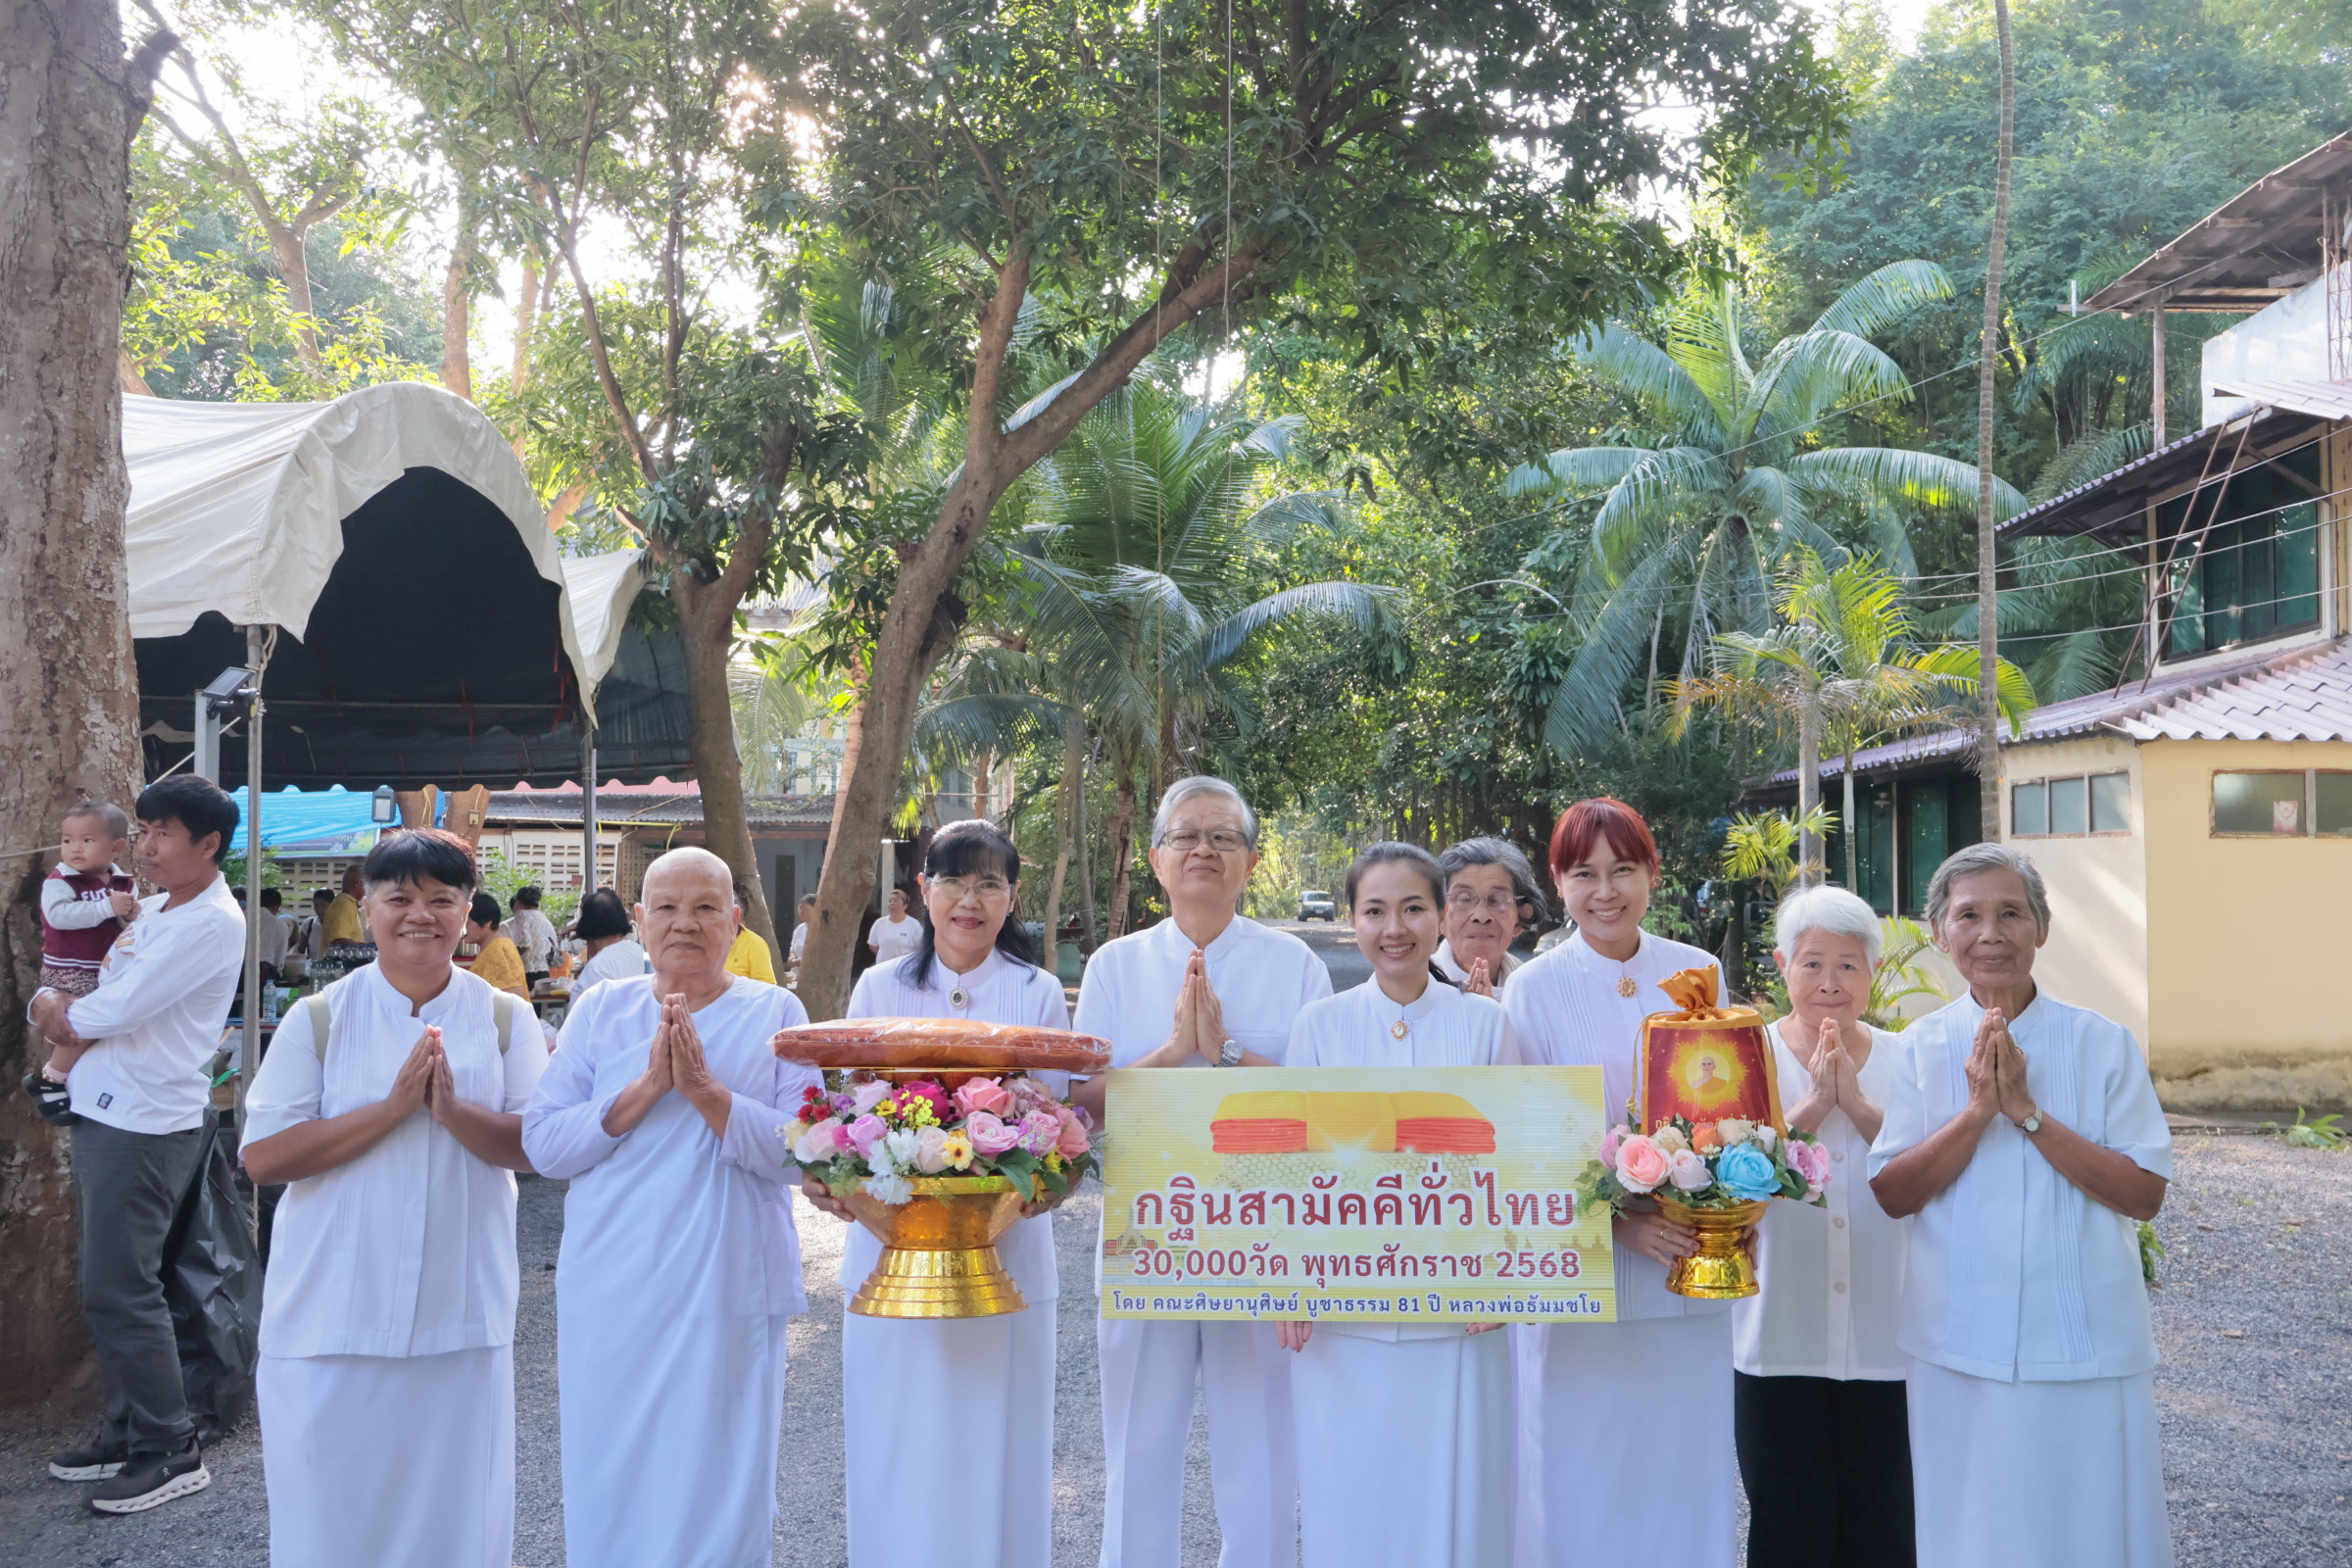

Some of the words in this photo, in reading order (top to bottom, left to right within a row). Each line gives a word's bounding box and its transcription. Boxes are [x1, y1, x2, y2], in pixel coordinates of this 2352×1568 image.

[1137, 1162, 1574, 1241] กฐินสามัคคีทั่วไทย
[1134, 1243, 1288, 1281] 30,000วัด
[1301, 1244, 1482, 1289] พุทธศักราช
[1496, 1251, 1580, 1278] 2568
[1113, 1291, 1146, 1310] โดย
[1154, 1292, 1298, 1317] คณะศิษยานุศิษย์
[1306, 1298, 1390, 1318] บูชาธรรม
[1398, 1298, 1420, 1312] 81
[1428, 1294, 1441, 1312] ปี
[1449, 1294, 1601, 1313] หลวงพ่อธัมมชโย
